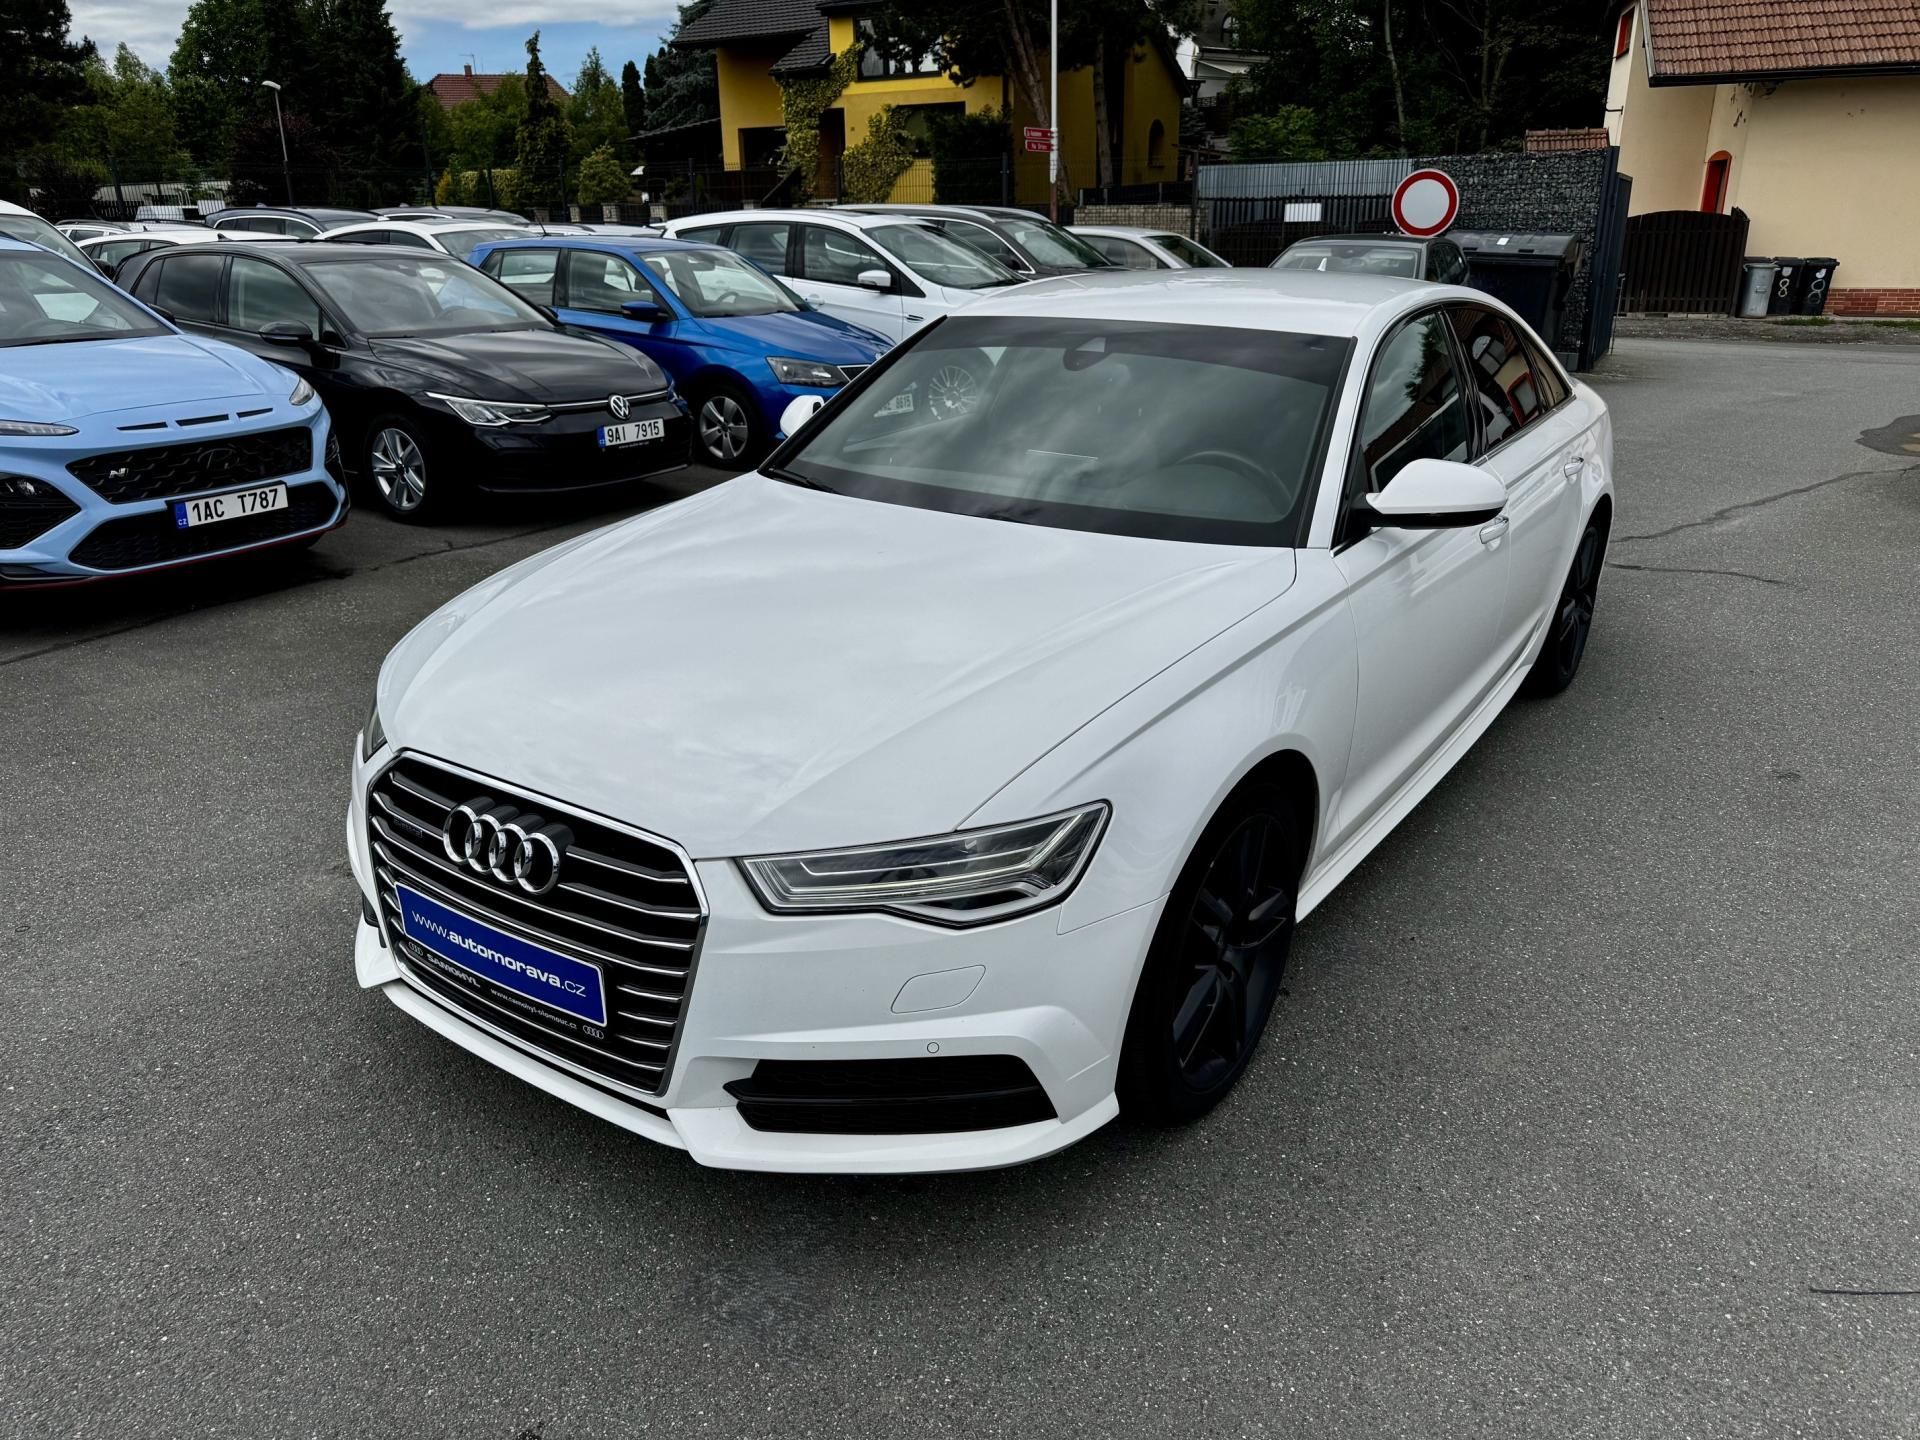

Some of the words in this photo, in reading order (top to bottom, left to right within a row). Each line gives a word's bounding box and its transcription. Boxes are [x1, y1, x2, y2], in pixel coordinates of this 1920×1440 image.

[607, 426, 626, 443] 9AI
[634, 421, 660, 439] 7915
[192, 499, 225, 522] 1AC
[237, 488, 278, 513] T787
[411, 910, 587, 998] www.automorava.cz
